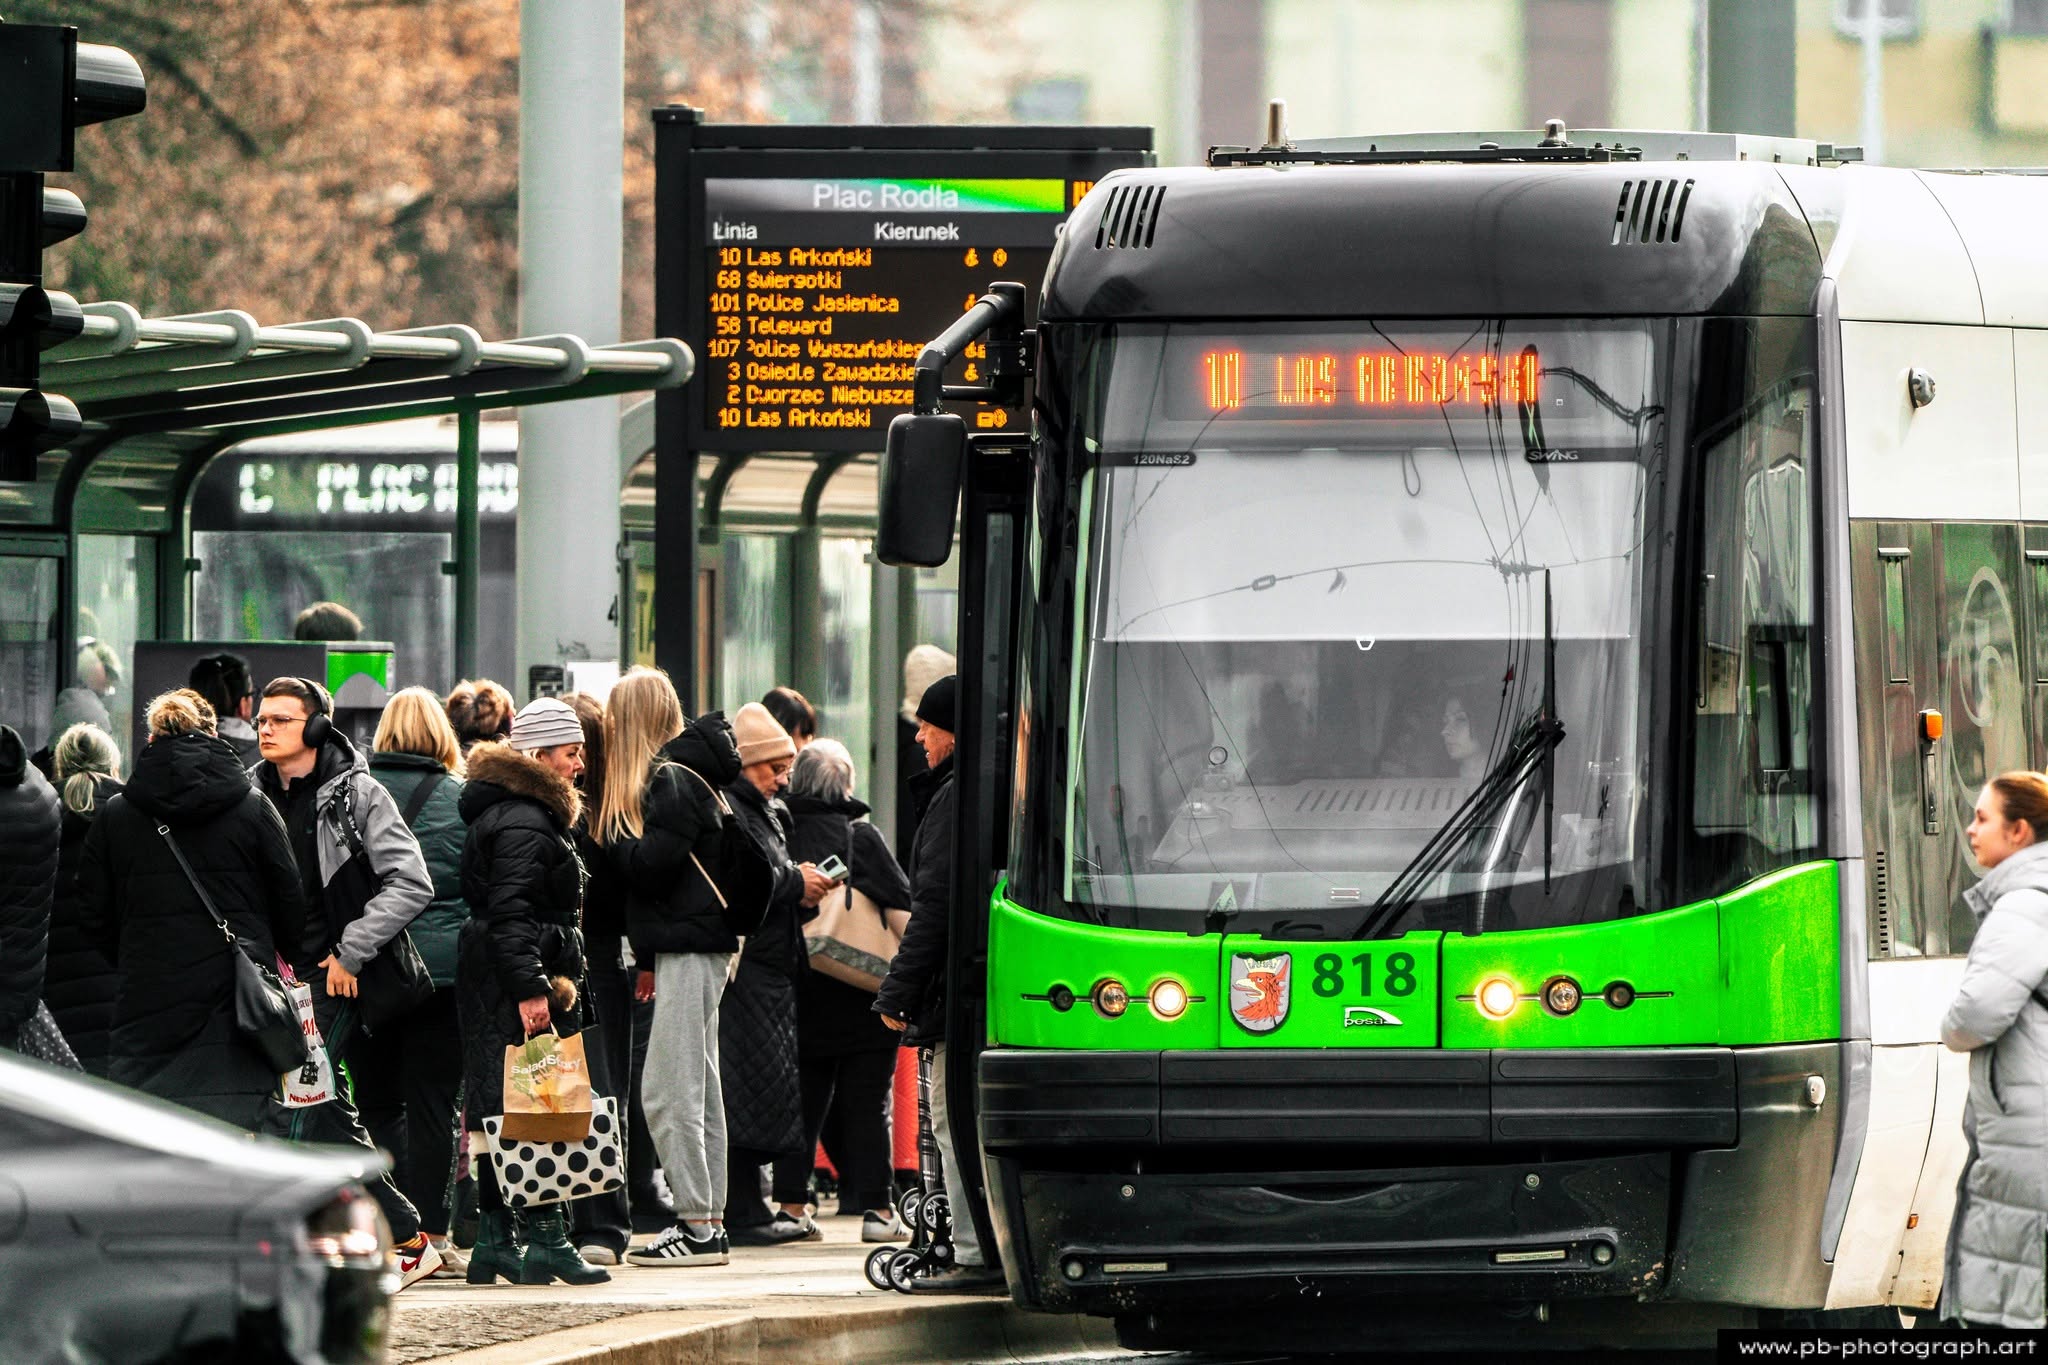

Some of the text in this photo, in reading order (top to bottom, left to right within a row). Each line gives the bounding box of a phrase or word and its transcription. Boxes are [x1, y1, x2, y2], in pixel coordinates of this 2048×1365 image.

[813, 183, 959, 208] Plac Rodła
[713, 222, 758, 241] Linia
[874, 222, 960, 241] Kierunek
[719, 247, 872, 266] 10 Las Arkoński
[716, 270, 741, 289] 68
[710, 293, 899, 312] 101 Police Jasienica
[716, 316, 741, 335] 58
[707, 339, 740, 358] 107
[728, 362, 741, 381] 3
[746, 362, 815, 381] Osiedle
[1207, 352, 1240, 408] 10
[727, 385, 740, 404] 2
[745, 385, 824, 404] Dworzec
[718, 407, 871, 427] 10 Las Arkoński
[1133, 454, 1190, 465] 120NaS2
[1311, 952, 1417, 998] 818
